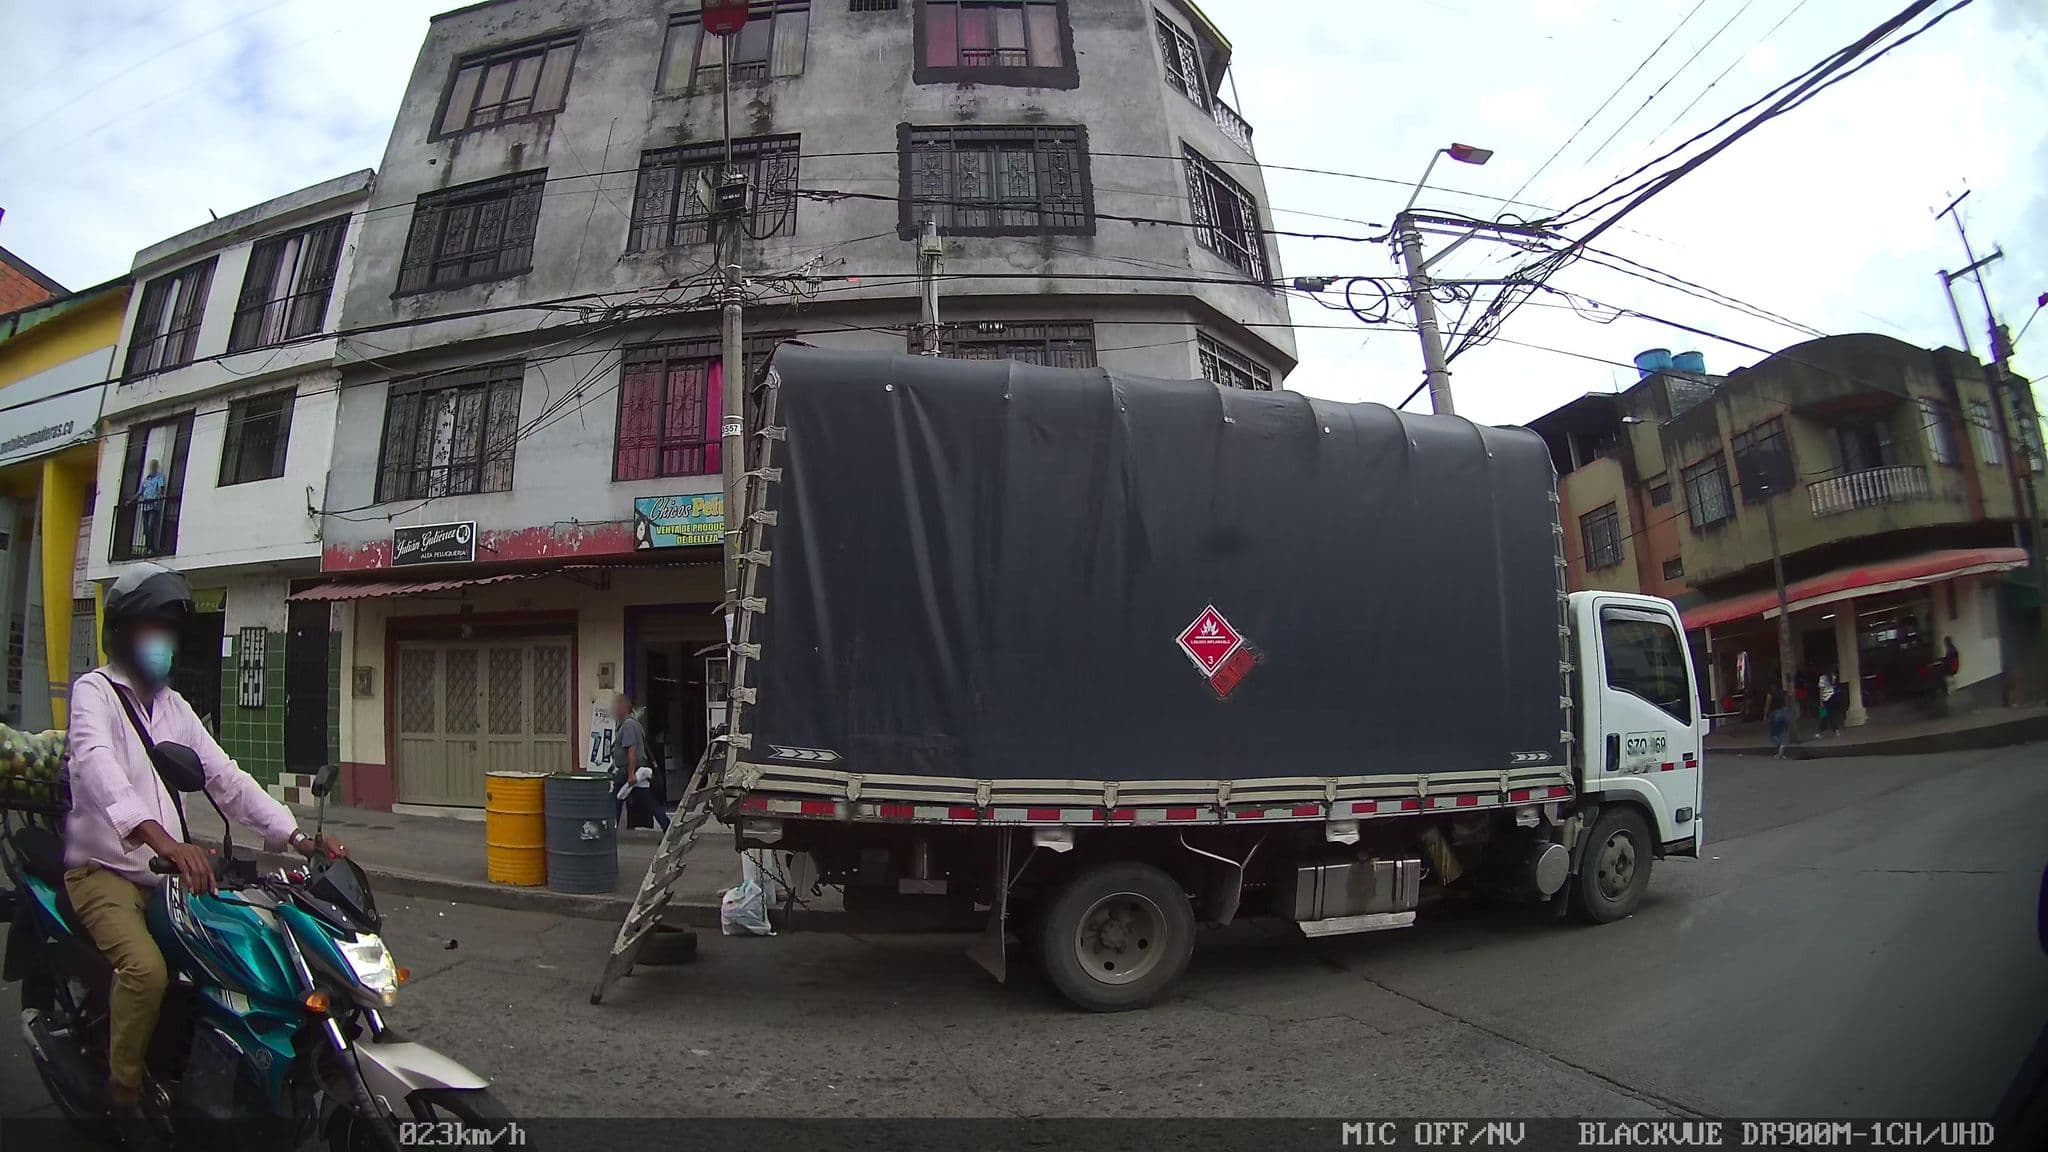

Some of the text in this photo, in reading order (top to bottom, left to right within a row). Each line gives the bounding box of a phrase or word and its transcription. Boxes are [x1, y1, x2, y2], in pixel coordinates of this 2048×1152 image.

[650, 497, 691, 521] Chicos
[656, 524, 680, 534] VENTA
[681, 524, 691, 533] DE
[676, 534, 719, 544] DE BELLEZA
[1207, 655, 1214, 664] 3
